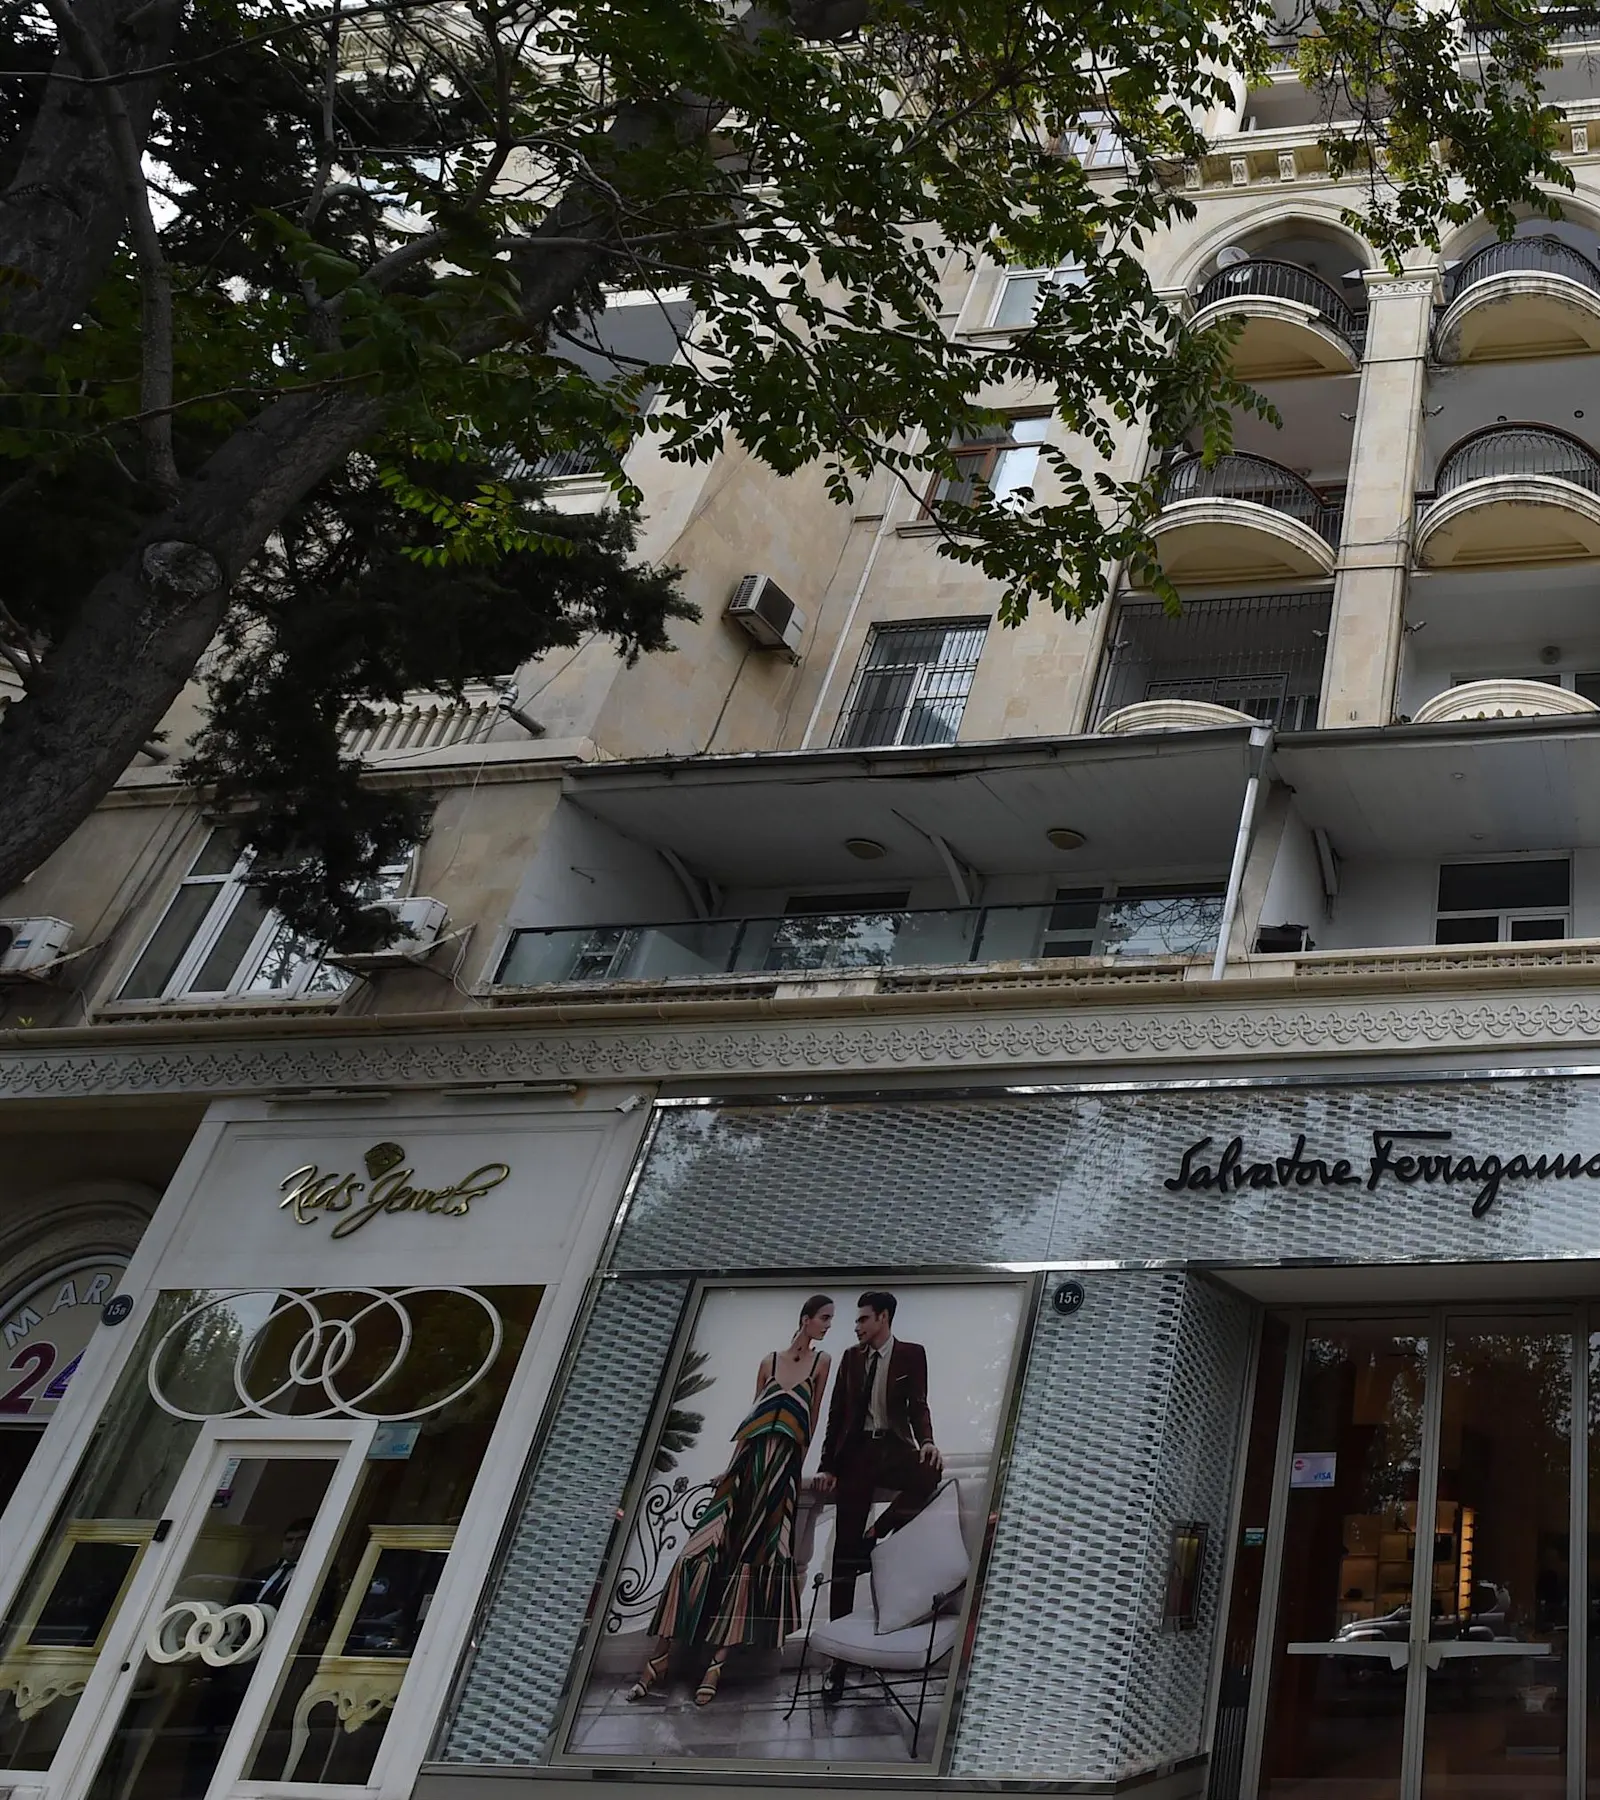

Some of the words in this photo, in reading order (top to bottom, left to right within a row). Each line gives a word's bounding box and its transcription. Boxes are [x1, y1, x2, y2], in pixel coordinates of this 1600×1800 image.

[279, 1163, 365, 1225] Kids
[331, 1162, 510, 1240] Jewels
[1164, 1135, 1362, 1193] Salvatore
[3, 1272, 113, 1350] MAR
